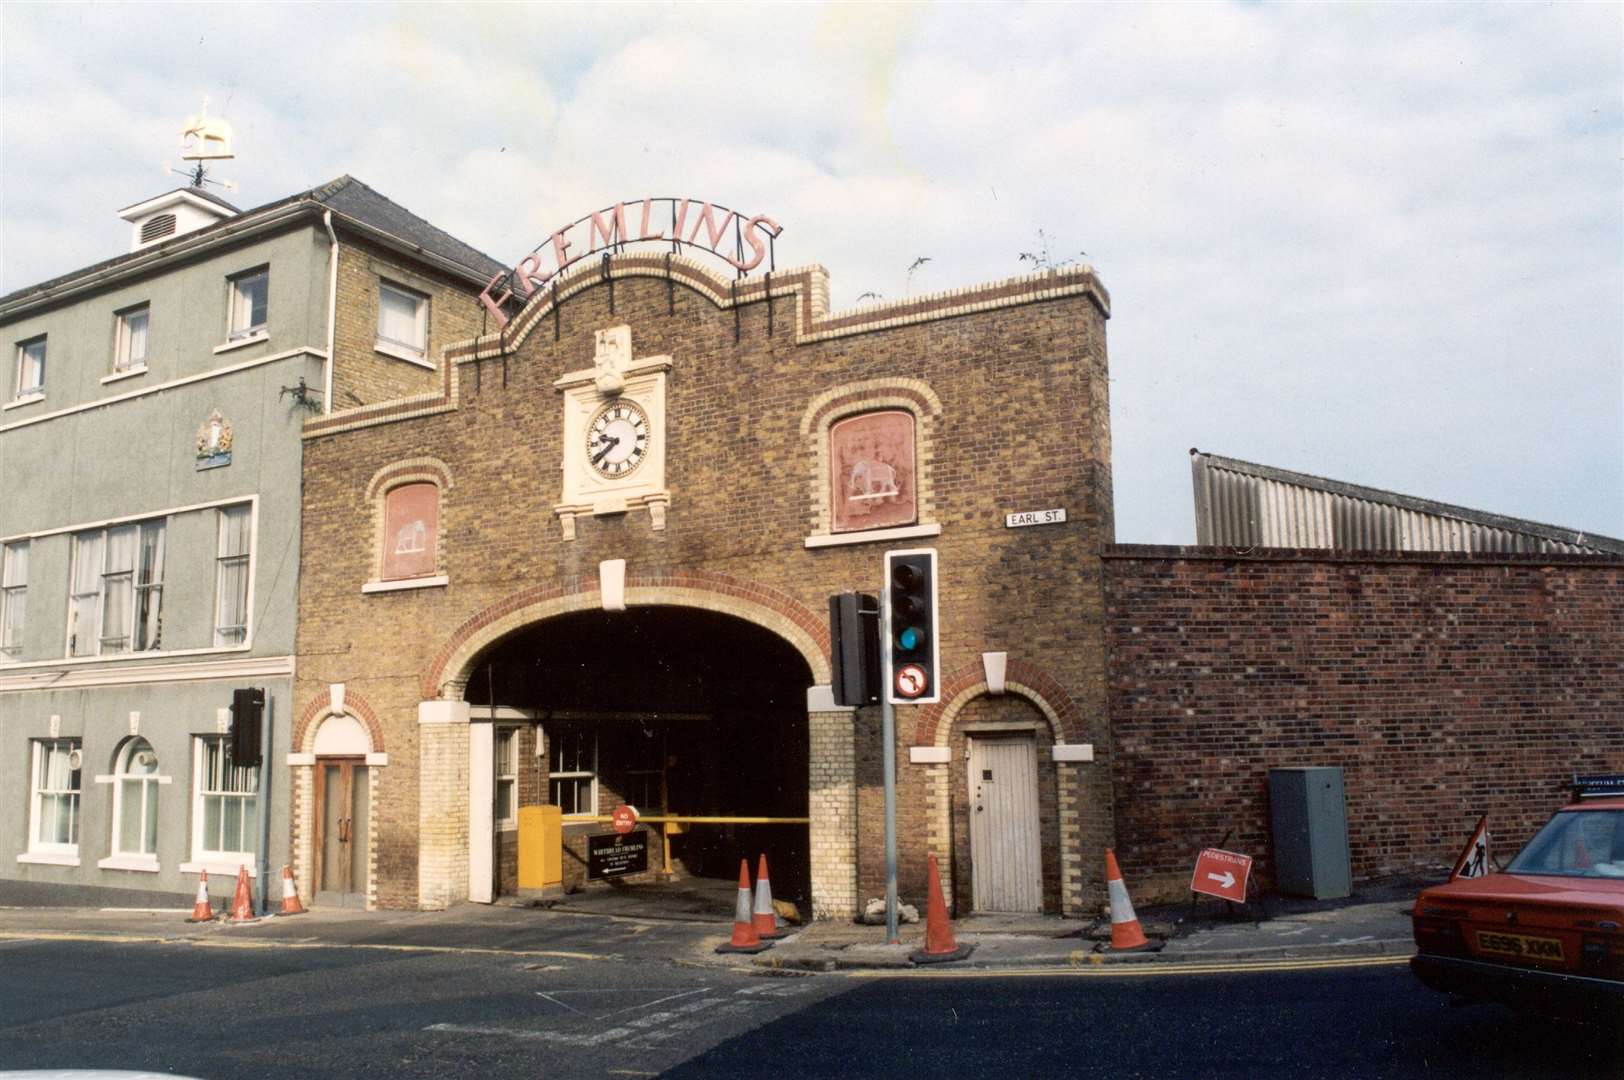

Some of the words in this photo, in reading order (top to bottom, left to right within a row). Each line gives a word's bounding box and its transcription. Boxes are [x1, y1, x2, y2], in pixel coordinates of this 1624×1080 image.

[478, 198, 783, 328] FREMLINS
[1011, 513, 1039, 525] EARL
[1202, 850, 1247, 866] PEDESTRIANS
